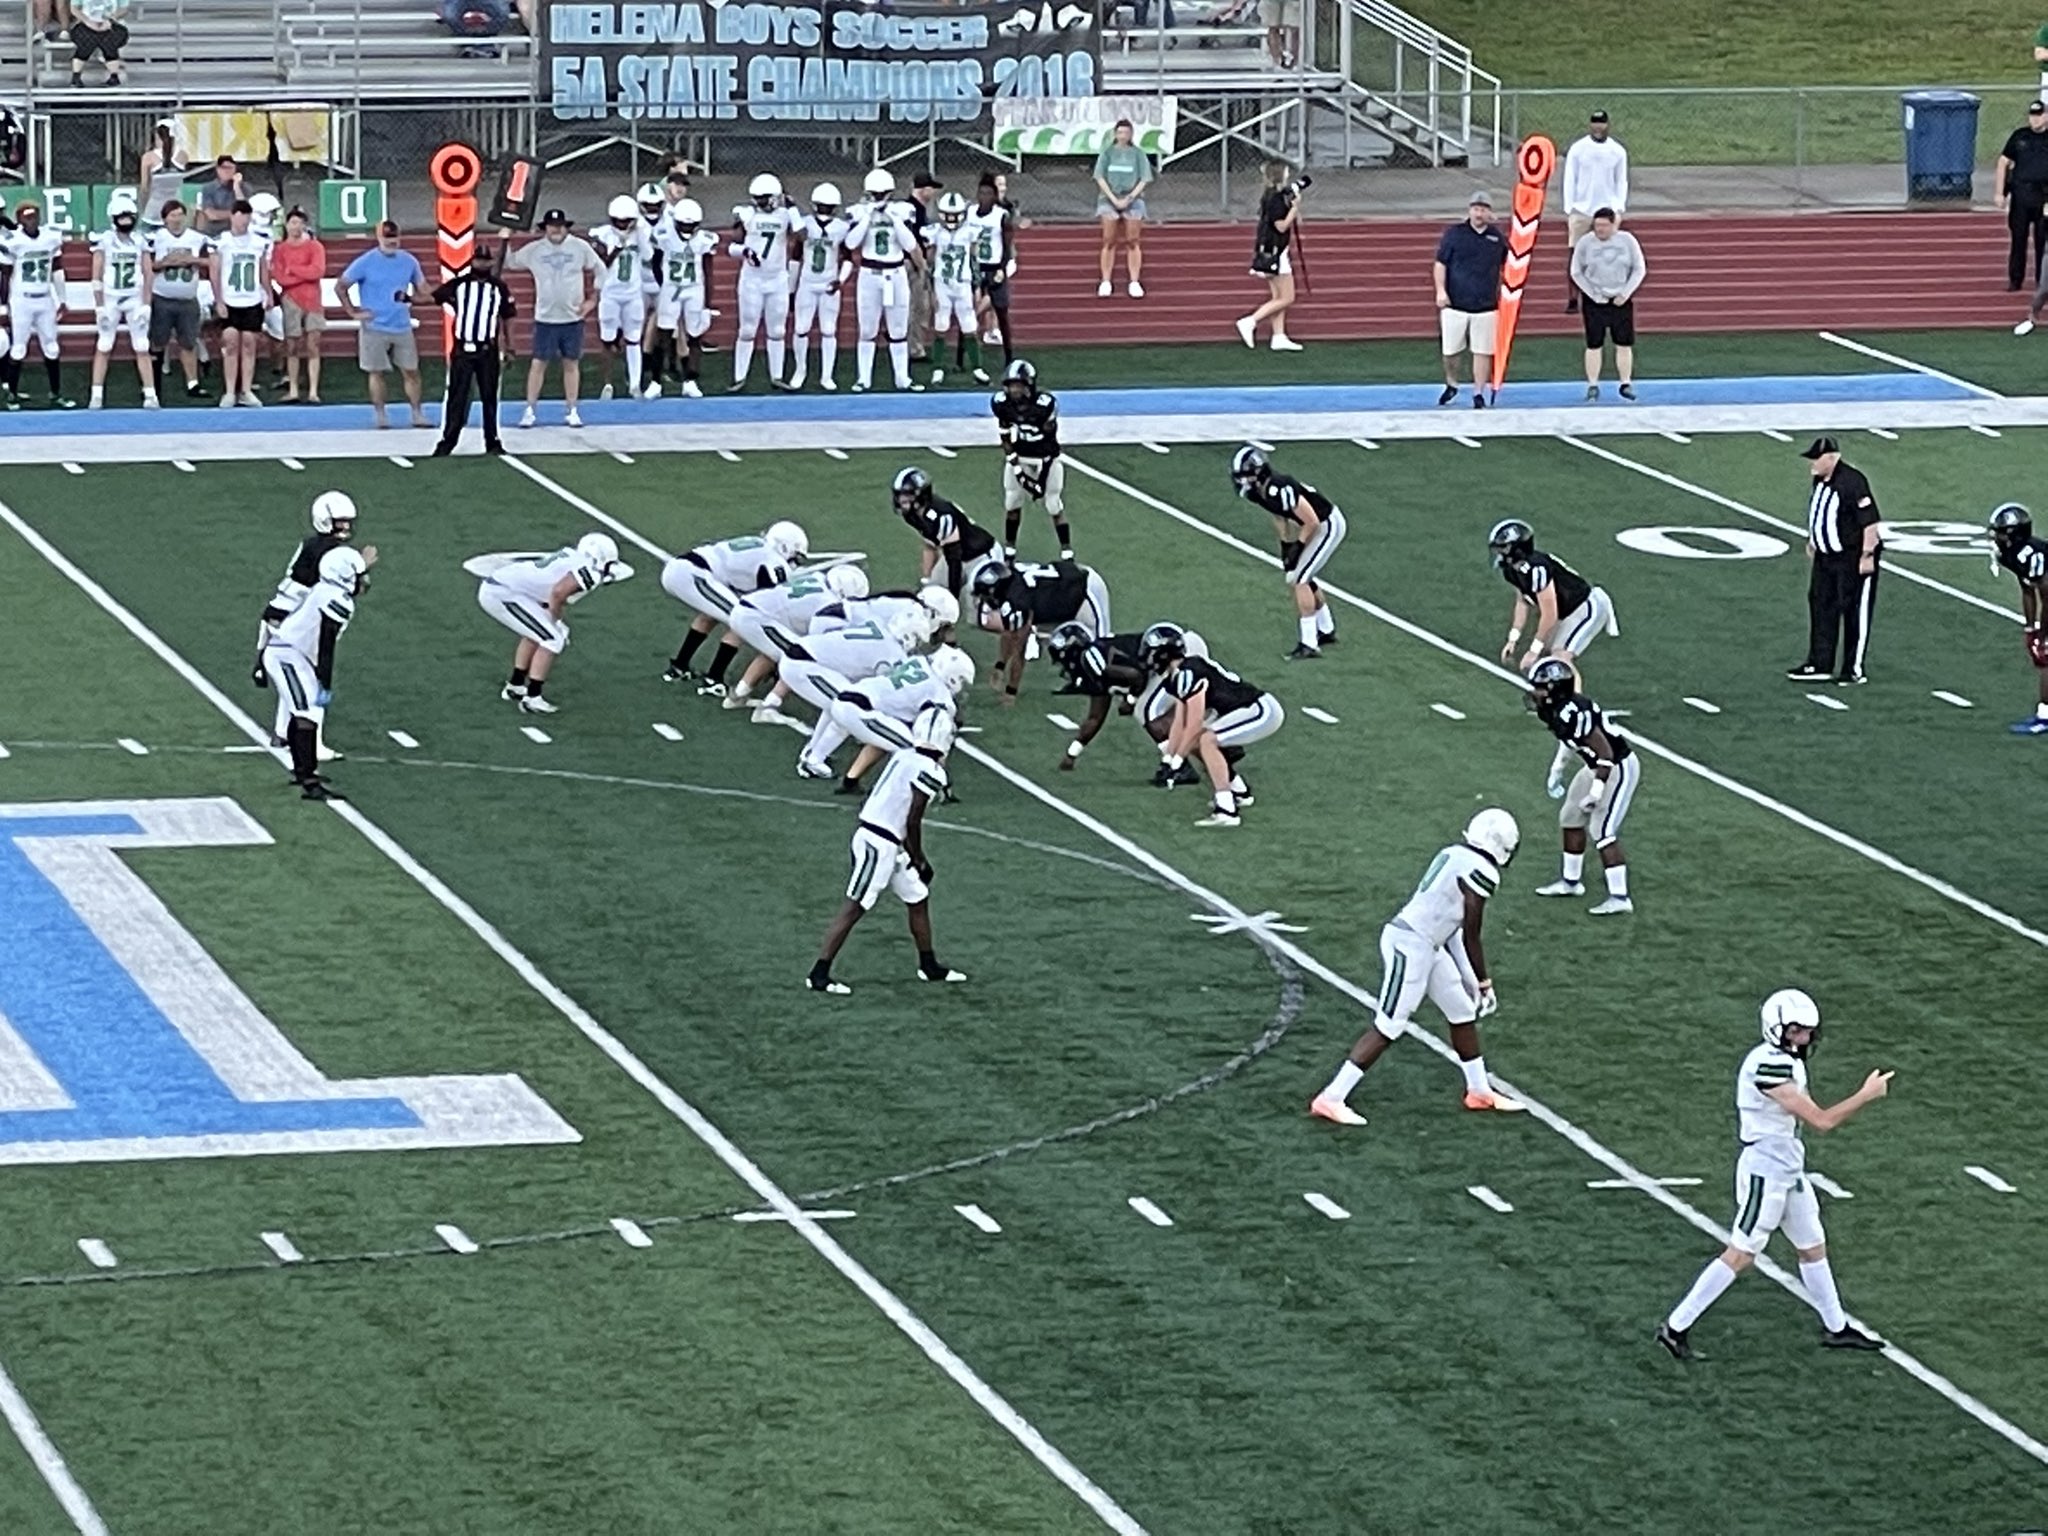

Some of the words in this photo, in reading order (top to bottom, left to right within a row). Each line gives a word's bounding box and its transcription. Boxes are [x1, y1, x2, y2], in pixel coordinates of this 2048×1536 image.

[550, 4, 705, 43] HELENA
[716, 4, 821, 46] BOYS
[832, 11, 988, 50] SOCCER
[552, 56, 607, 119] 5A
[618, 55, 738, 120] STATE
[748, 55, 983, 122] CHAMPIONS
[507, 161, 529, 202] 1
[761, 231, 775, 259] 7
[112, 262, 135, 289] 12
